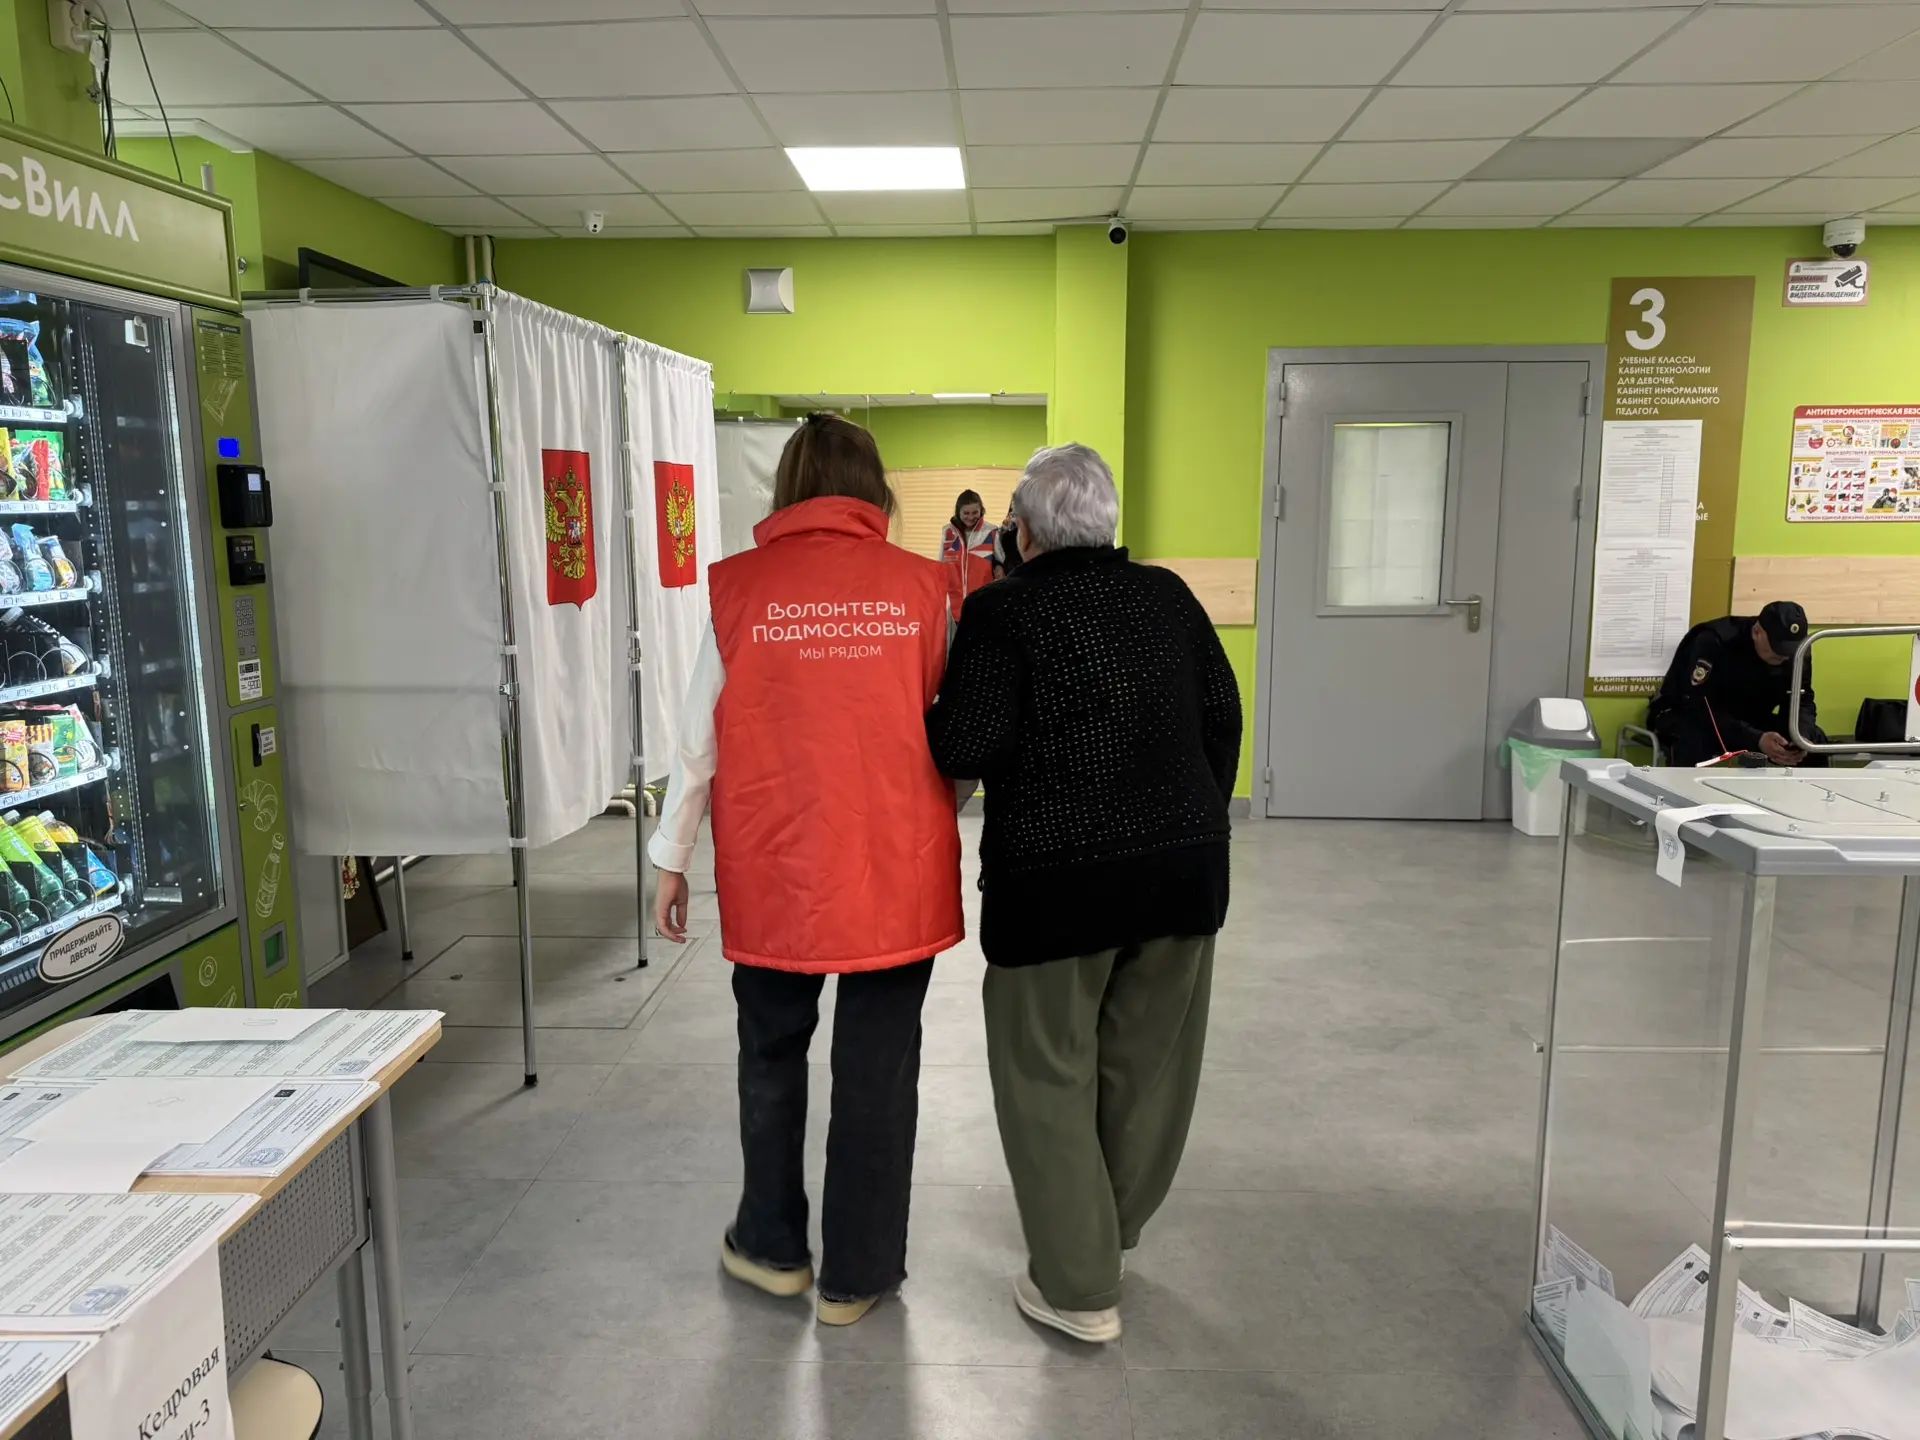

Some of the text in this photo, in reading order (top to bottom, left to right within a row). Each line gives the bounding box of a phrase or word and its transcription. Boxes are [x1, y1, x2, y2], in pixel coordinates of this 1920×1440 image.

[1625, 287, 1666, 350] 3
[1619, 356, 1696, 364] УЧЕБНЫЕ КЛАССЫ
[1619, 366, 1711, 375] КАБИНЕТ ТЕХНОЛОГИИ
[1617, 377, 1675, 385] ДЛЯ ДЕВОЧЕК
[1617, 386, 1718, 395] КАБИНЕТ ИНФОРМАТИКИ
[1616, 397, 1721, 405] КАБИНЕТ СОЦИАЛЬНОГО
[1615, 407, 1659, 415] ПЕДАГОГА
[1806, 408, 1903, 416] АНТИТЕРРОРИСТИЧЕСКАЯ
[799, 645, 882, 660] МЫ РЯДОМ
[1593, 684, 1657, 693] КАБИНЕТ ВРАЧА
[50, 922, 112, 961] ПРИДЕРЖИВАЙТЕ
[70, 942, 97, 965] ДВЕРЦУ
[138, 1346, 220, 1440] Кедровая
